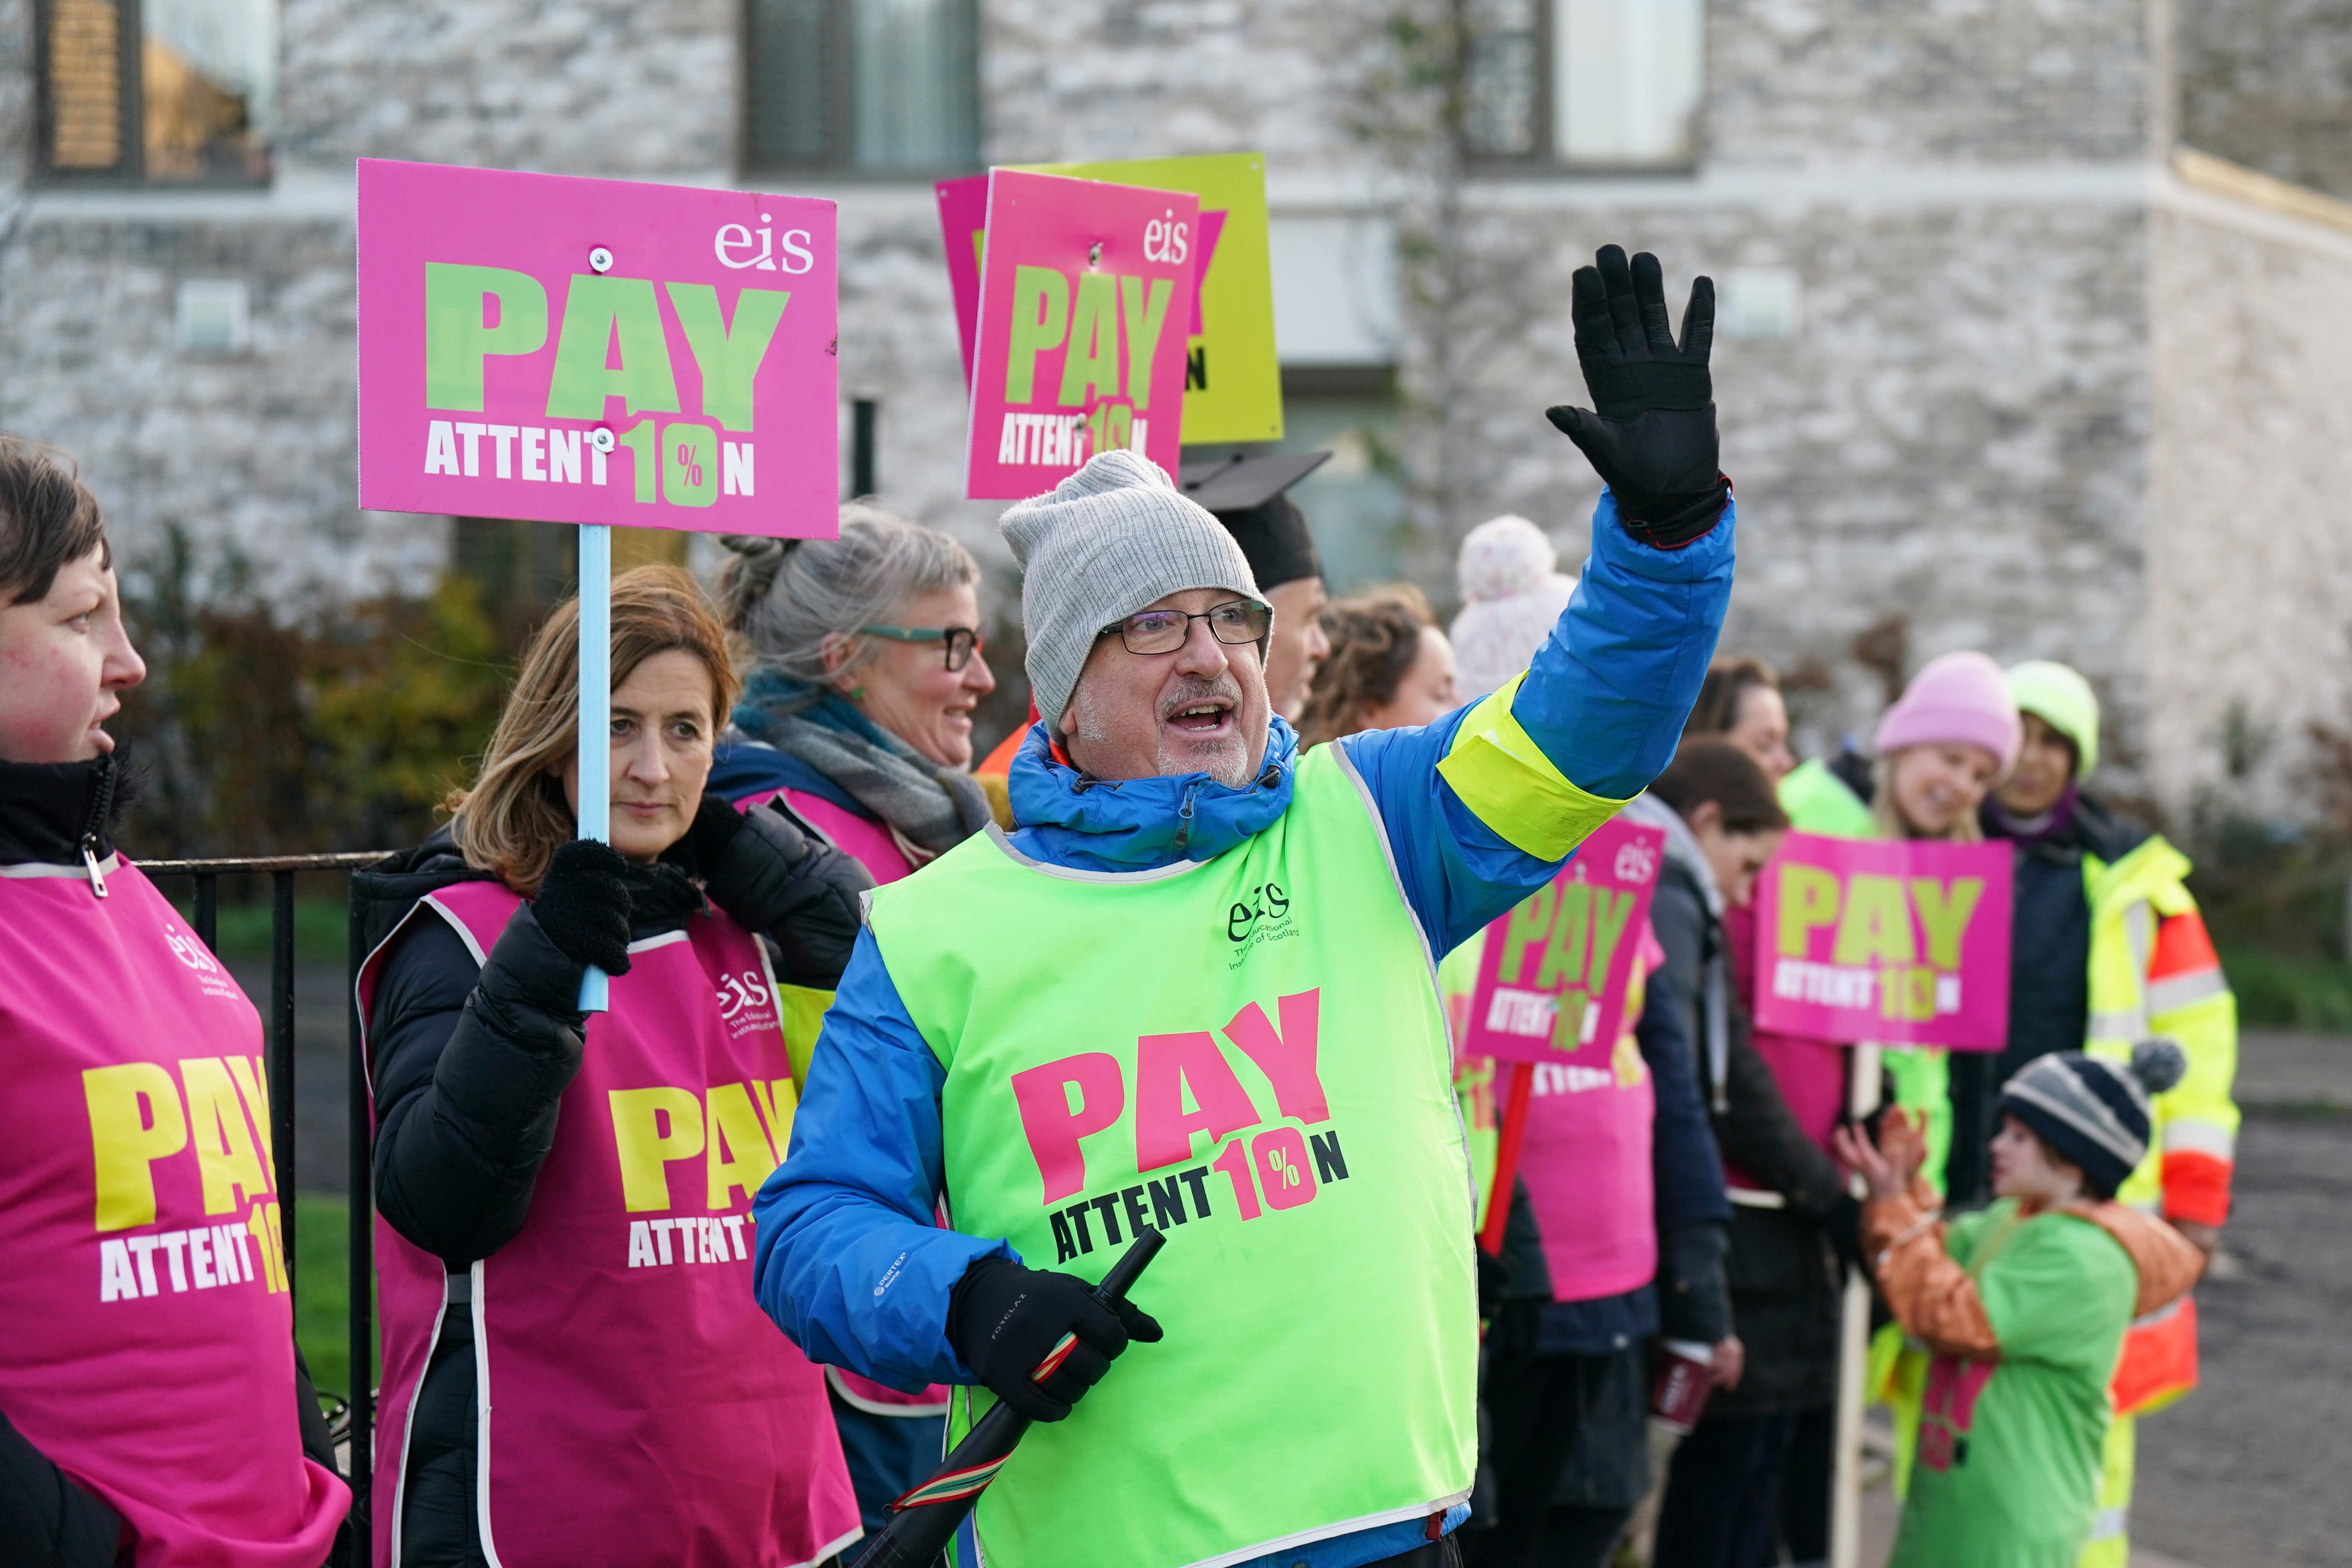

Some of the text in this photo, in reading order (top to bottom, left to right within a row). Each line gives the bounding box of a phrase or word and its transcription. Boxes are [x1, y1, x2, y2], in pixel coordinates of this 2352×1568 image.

[714, 213, 814, 274] eis
[1143, 209, 1188, 264] eis
[425, 261, 792, 433] PAY
[1004, 265, 1175, 411] PAY
[1228, 883, 1289, 942] eis
[1497, 879, 1636, 997] PAY
[1777, 862, 1985, 971] PAY
[1010, 987, 1330, 1207] PAY
[628, 1214, 755, 1268] ATTENT
